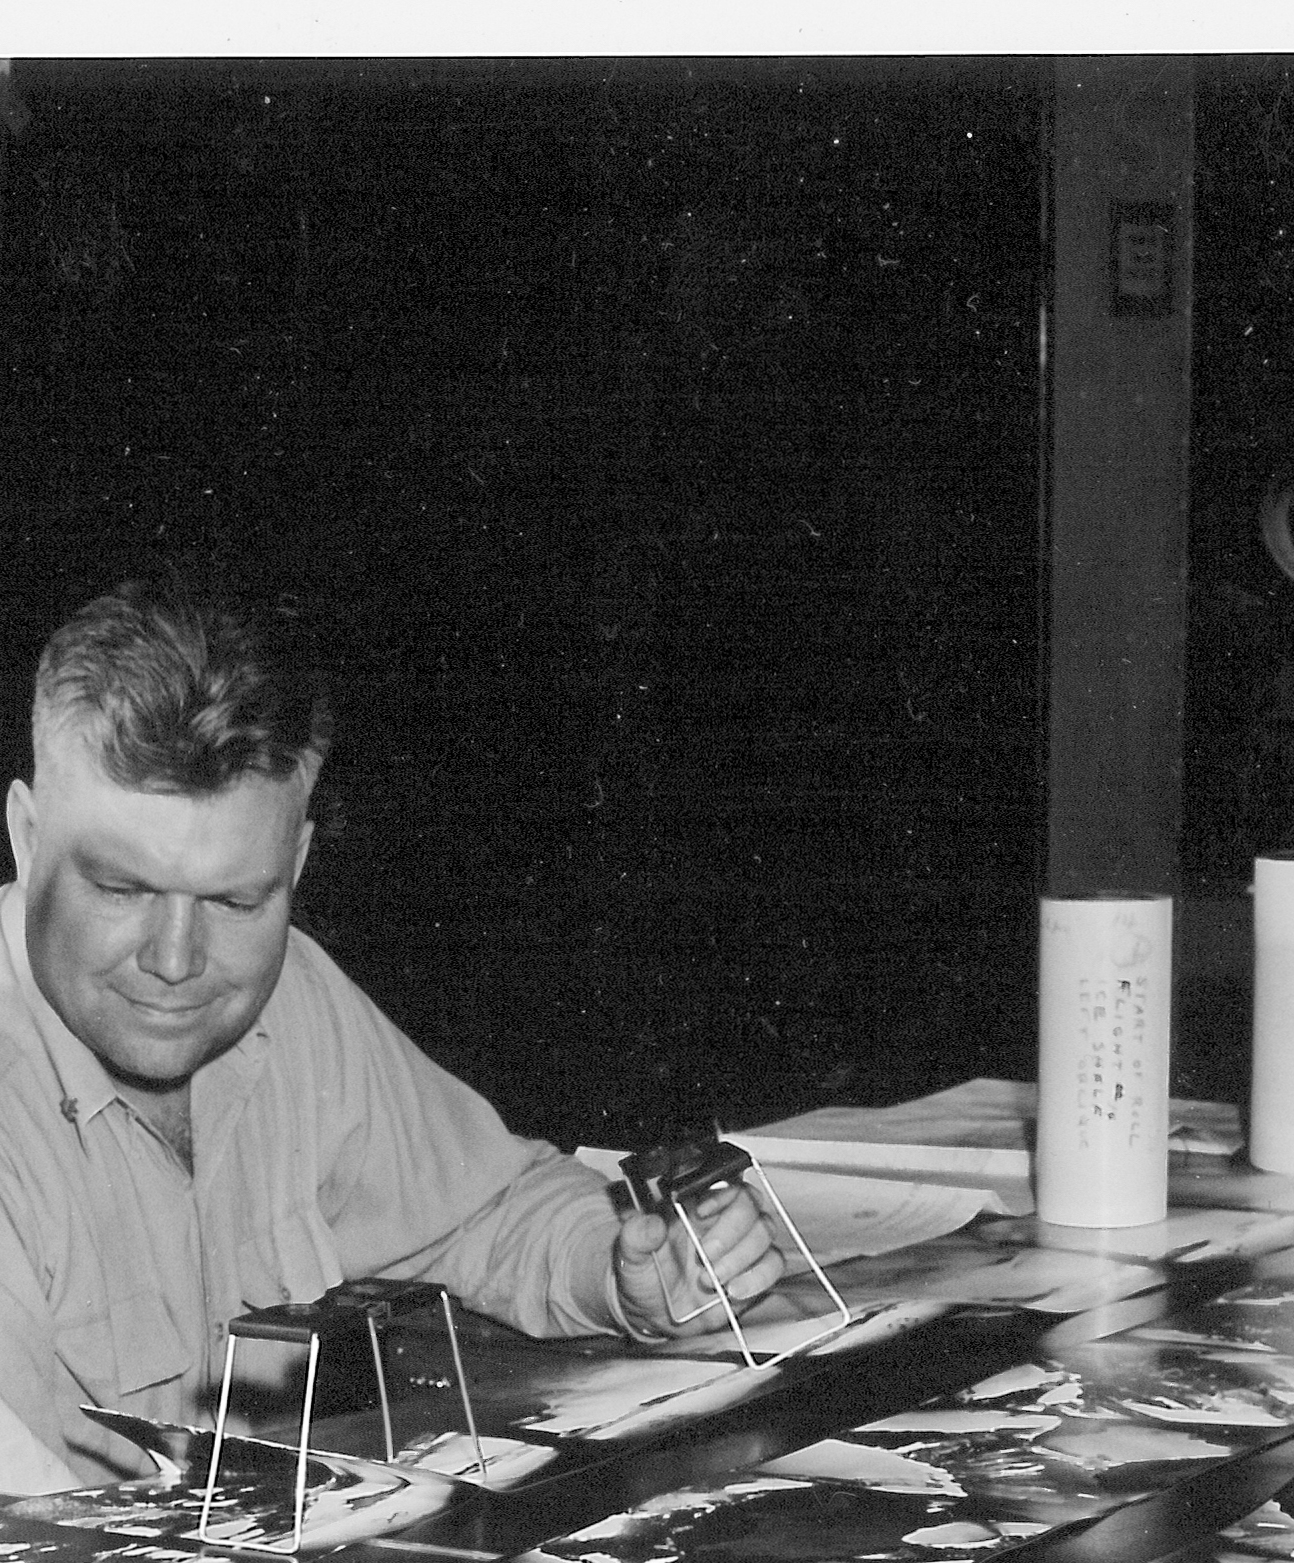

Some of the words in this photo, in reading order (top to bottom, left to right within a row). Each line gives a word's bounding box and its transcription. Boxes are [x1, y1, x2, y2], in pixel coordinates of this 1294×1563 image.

[1077, 978, 1091, 1040] LEFT
[1093, 979, 1108, 1022] ICE
[1112, 978, 1132, 1072] FLIGHT
[1132, 975, 1149, 1044] START
[1091, 1040, 1104, 1118] SHELF
[1131, 1059, 1144, 1081] OF
[1127, 1096, 1144, 1149] ROLL
